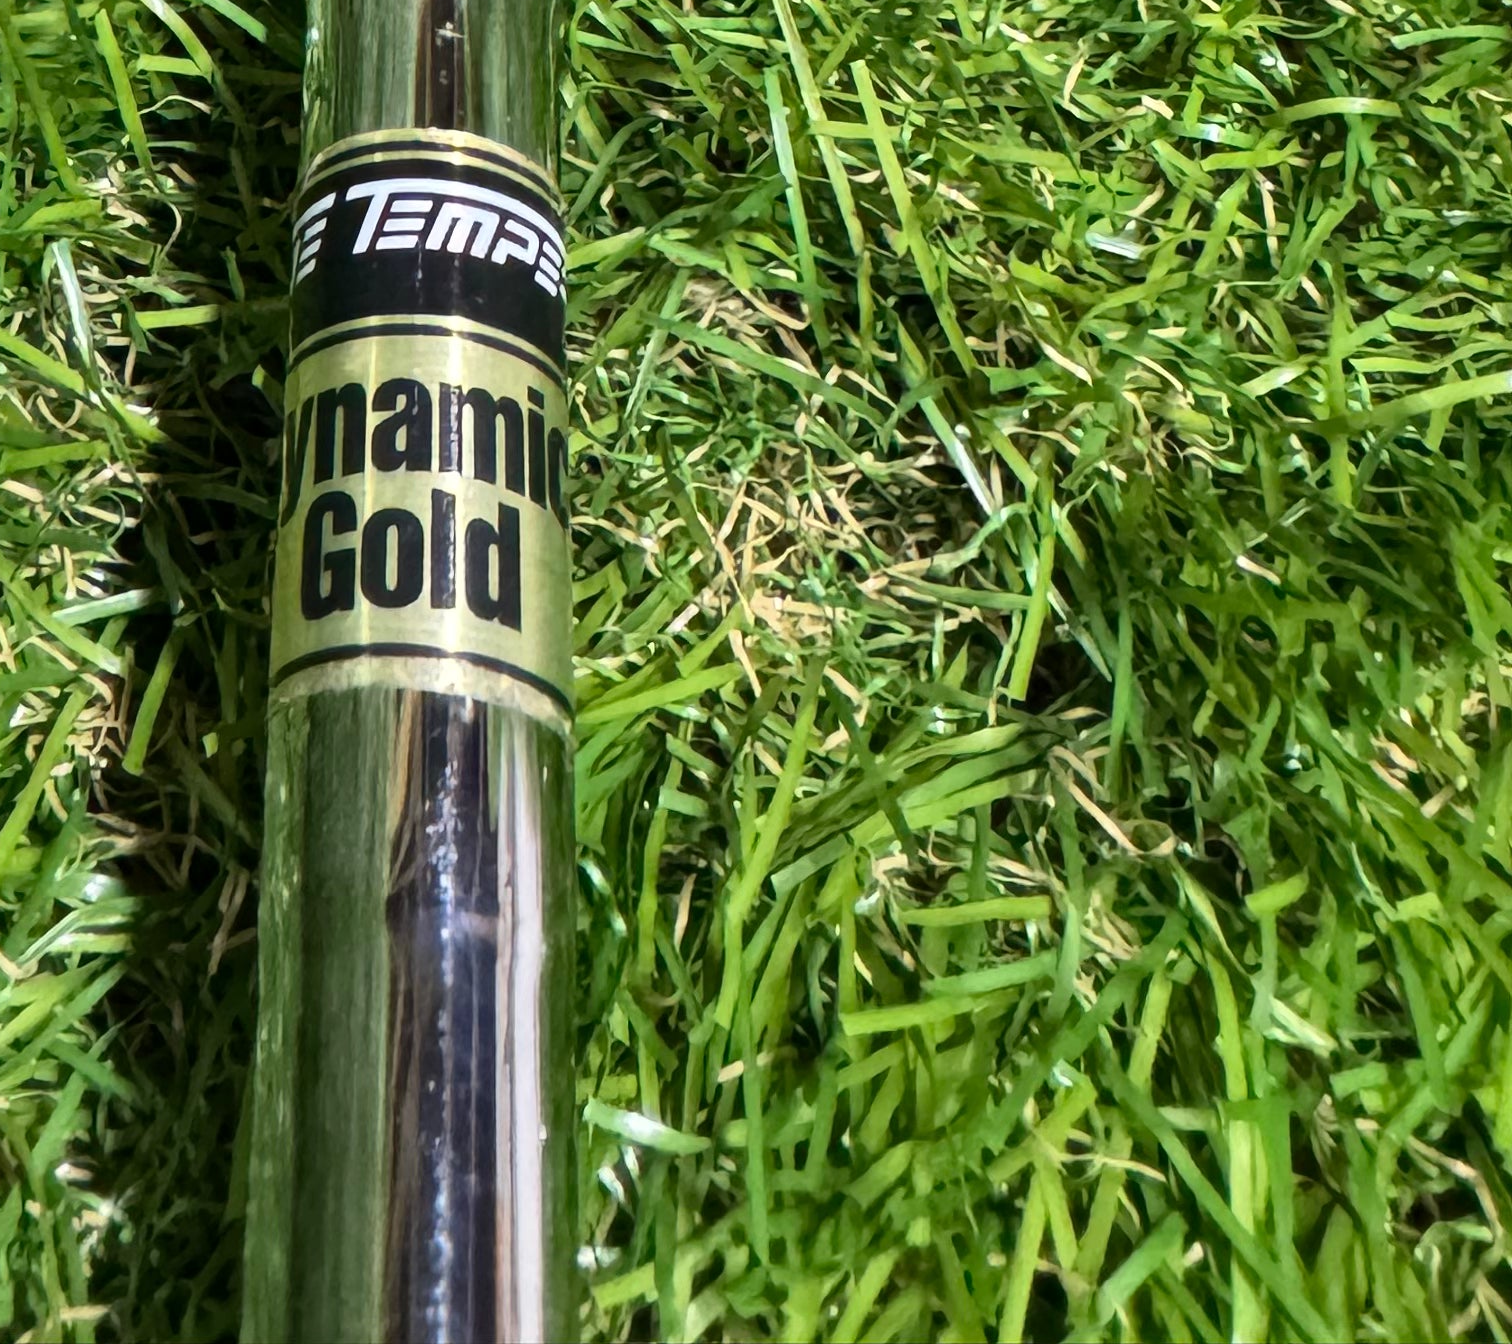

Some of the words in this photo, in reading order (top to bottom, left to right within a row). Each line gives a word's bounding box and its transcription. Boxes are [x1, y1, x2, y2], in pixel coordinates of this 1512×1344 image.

[346, 178, 567, 302] TEMPE
[281, 377, 569, 529] ynamic
[301, 488, 522, 632] Gold
